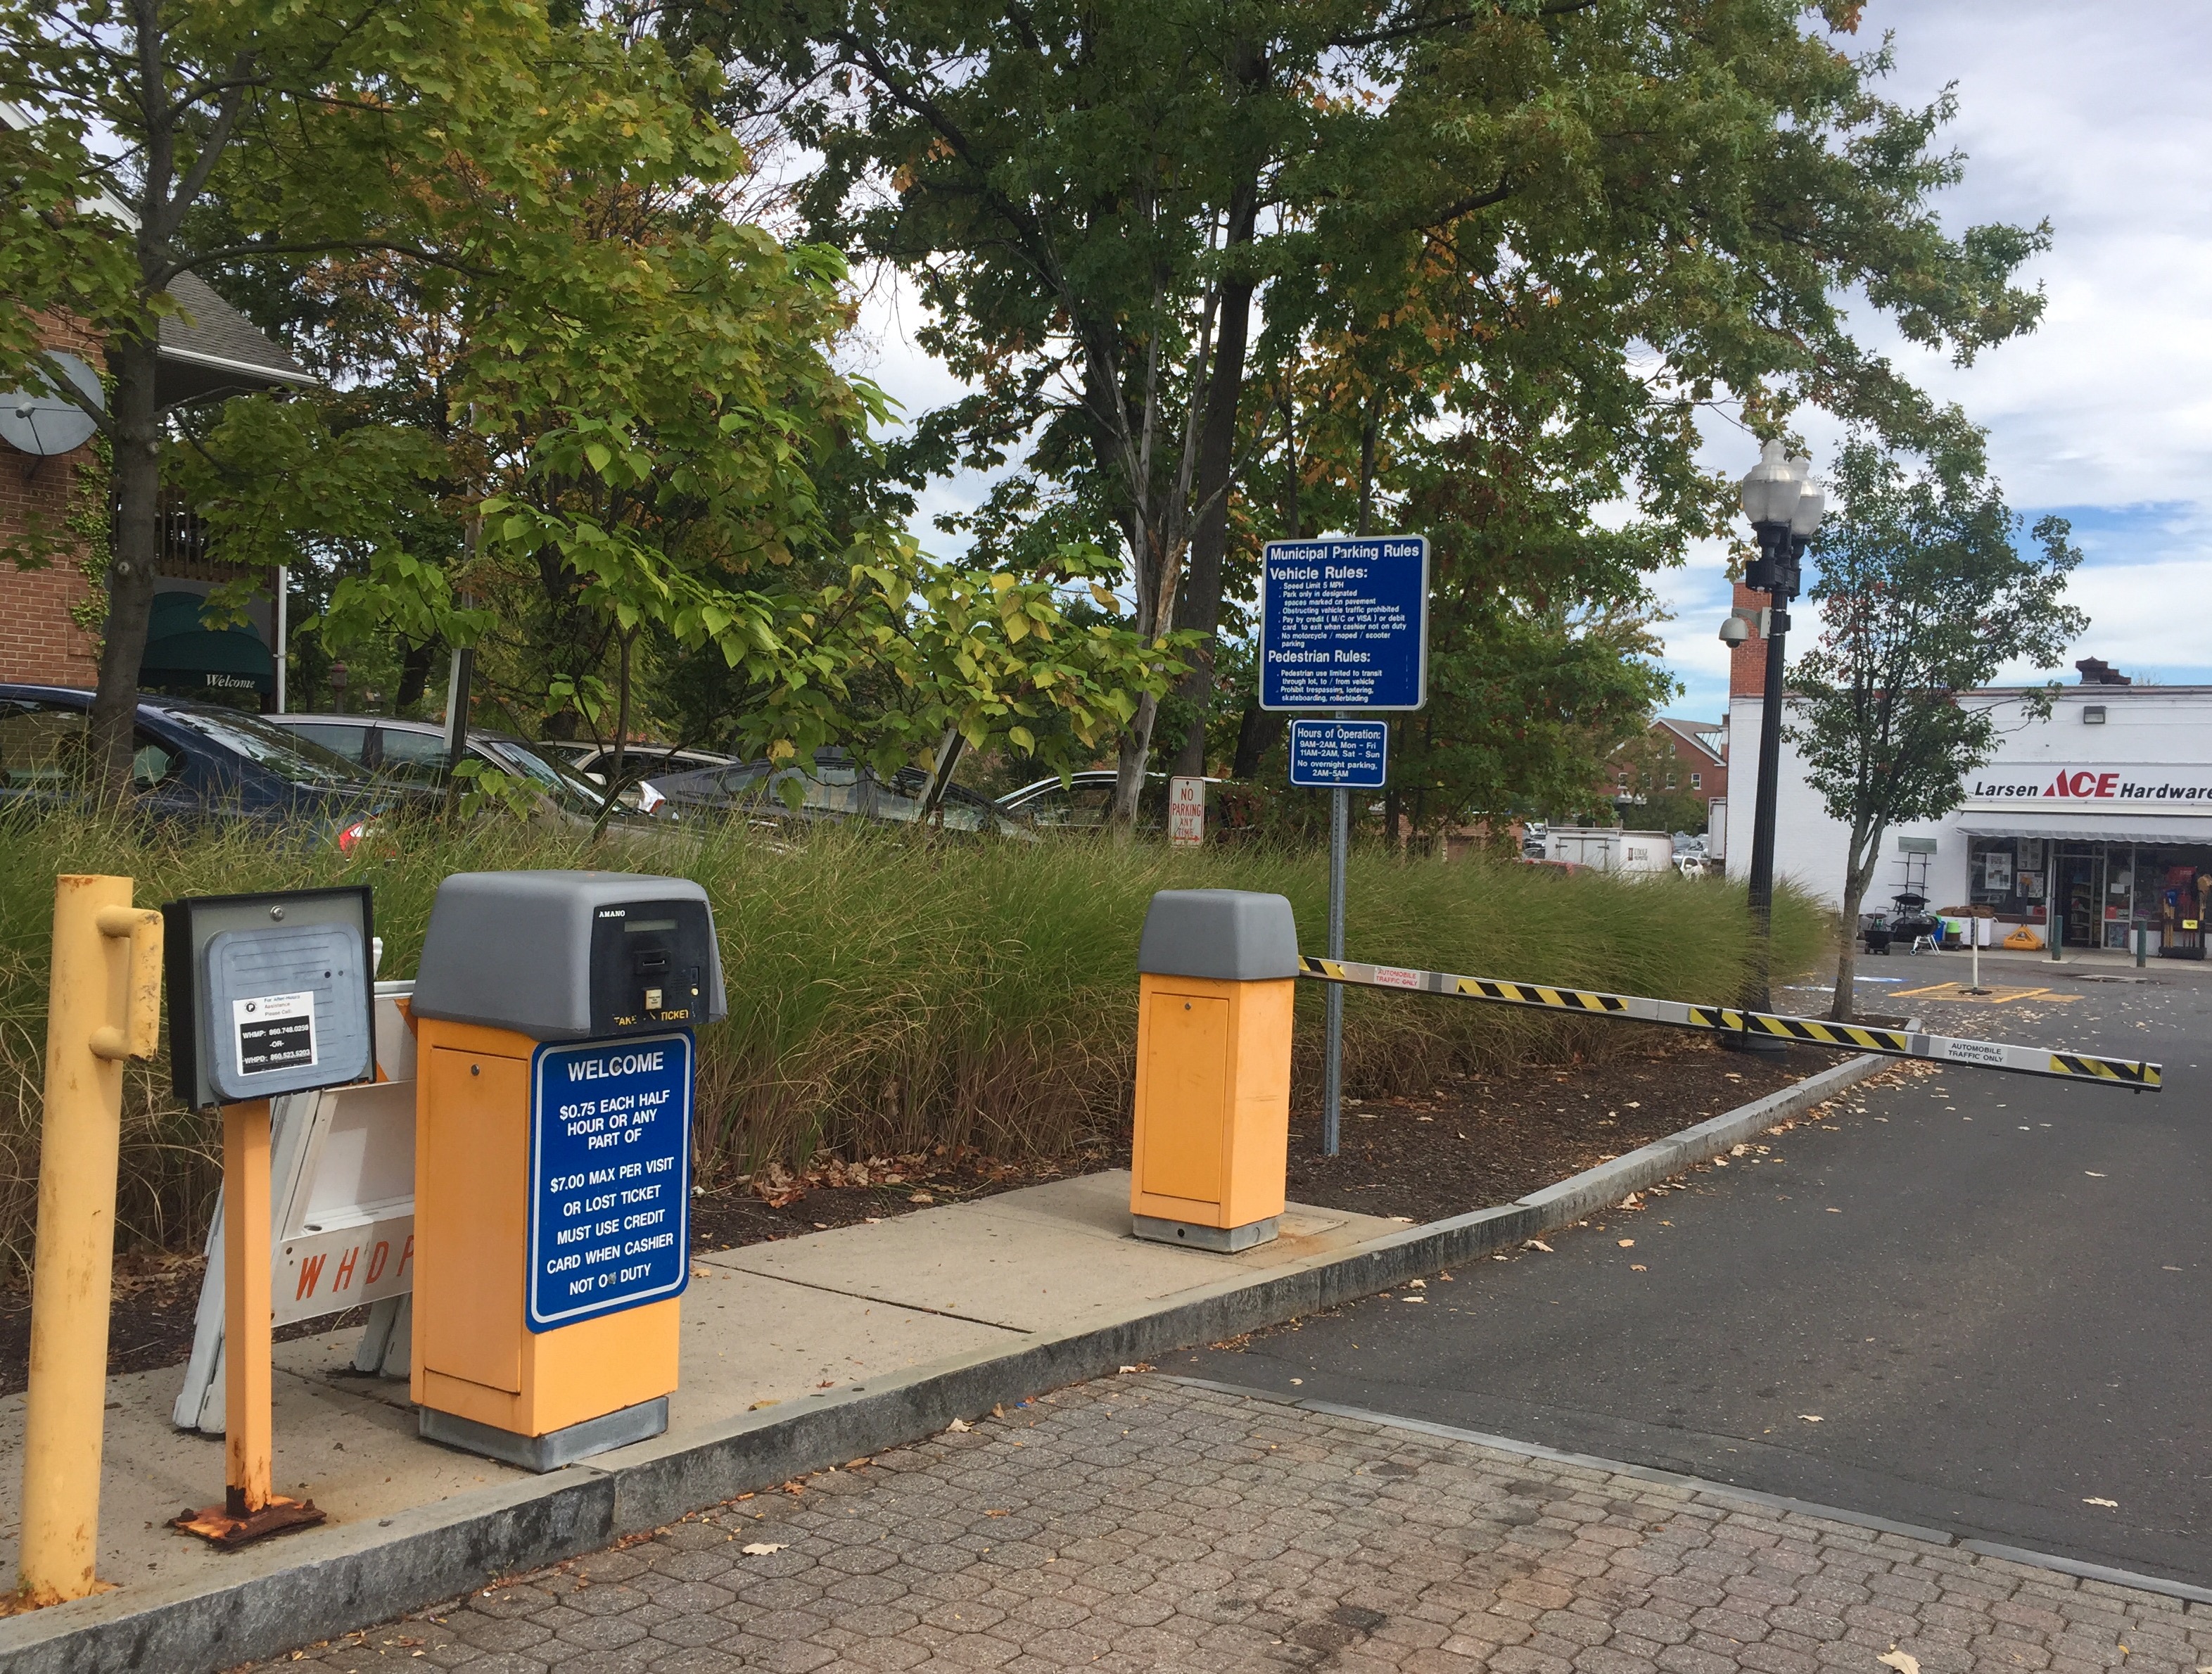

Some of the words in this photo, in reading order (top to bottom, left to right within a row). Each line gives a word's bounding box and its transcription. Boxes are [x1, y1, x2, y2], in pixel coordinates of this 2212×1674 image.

[1271, 547, 1327, 562] Municipal
[1333, 545, 1378, 560] Parking
[1384, 544, 1419, 557] Rules
[1270, 568, 1318, 580] Vehicle
[1326, 566, 1368, 579] Rules:
[1269, 650, 1330, 663] Pedestrian
[1335, 650, 1371, 663] Rules:
[206, 674, 255, 688] Welcome
[1298, 728, 1321, 738] Hours
[1325, 728, 1334, 738] of
[1337, 729, 1380, 740] Operation:
[1347, 761, 1378, 770] parking,
[1975, 782, 2038, 797] Larsen
[2042, 768, 2120, 798] ACE
[1181, 788, 1193, 801] NO
[1173, 804, 1200, 816] PARKING
[1378, 969, 1416, 979] AUTOMOBILE
[661, 1010, 688, 1021] TICKET
[243, 1030, 266, 1039] WHMP:
[1947, 1050, 1980, 1060] TRAFFIC
[1952, 1043, 2001, 1055] AUTOMOBILE
[245, 1055, 268, 1064] WHPD:
[568, 1051, 664, 1082] WELCOME
[559, 1101, 595, 1120] $0.75
[601, 1095, 635, 1113] EACH
[639, 1090, 670, 1107] HALF
[568, 1117, 604, 1136] HOUR
[610, 1113, 628, 1129] OR
[633, 1109, 658, 1125] ANY
[588, 1131, 620, 1150] PART
[625, 1129, 642, 1143] OF
[550, 1173, 585, 1193] $7.00
[590, 1167, 615, 1184] MAX
[620, 1162, 641, 1179] PER
[646, 1157, 674, 1173] VISIT
[564, 1202, 580, 1217] OR
[586, 1193, 616, 1212] LOST
[621, 1184, 661, 1205] TICKET
[557, 1225, 590, 1245] MUST
[596, 1219, 619, 1236] USE
[624, 1210, 665, 1231] CREDIT
[547, 1253, 580, 1274] CARD
[586, 1245, 621, 1265] WHEN
[625, 1233, 673, 1257] CASHIER
[570, 1276, 594, 1295] NOT
[599, 1272, 617, 1288] O
[621, 1264, 651, 1283] DUTY
